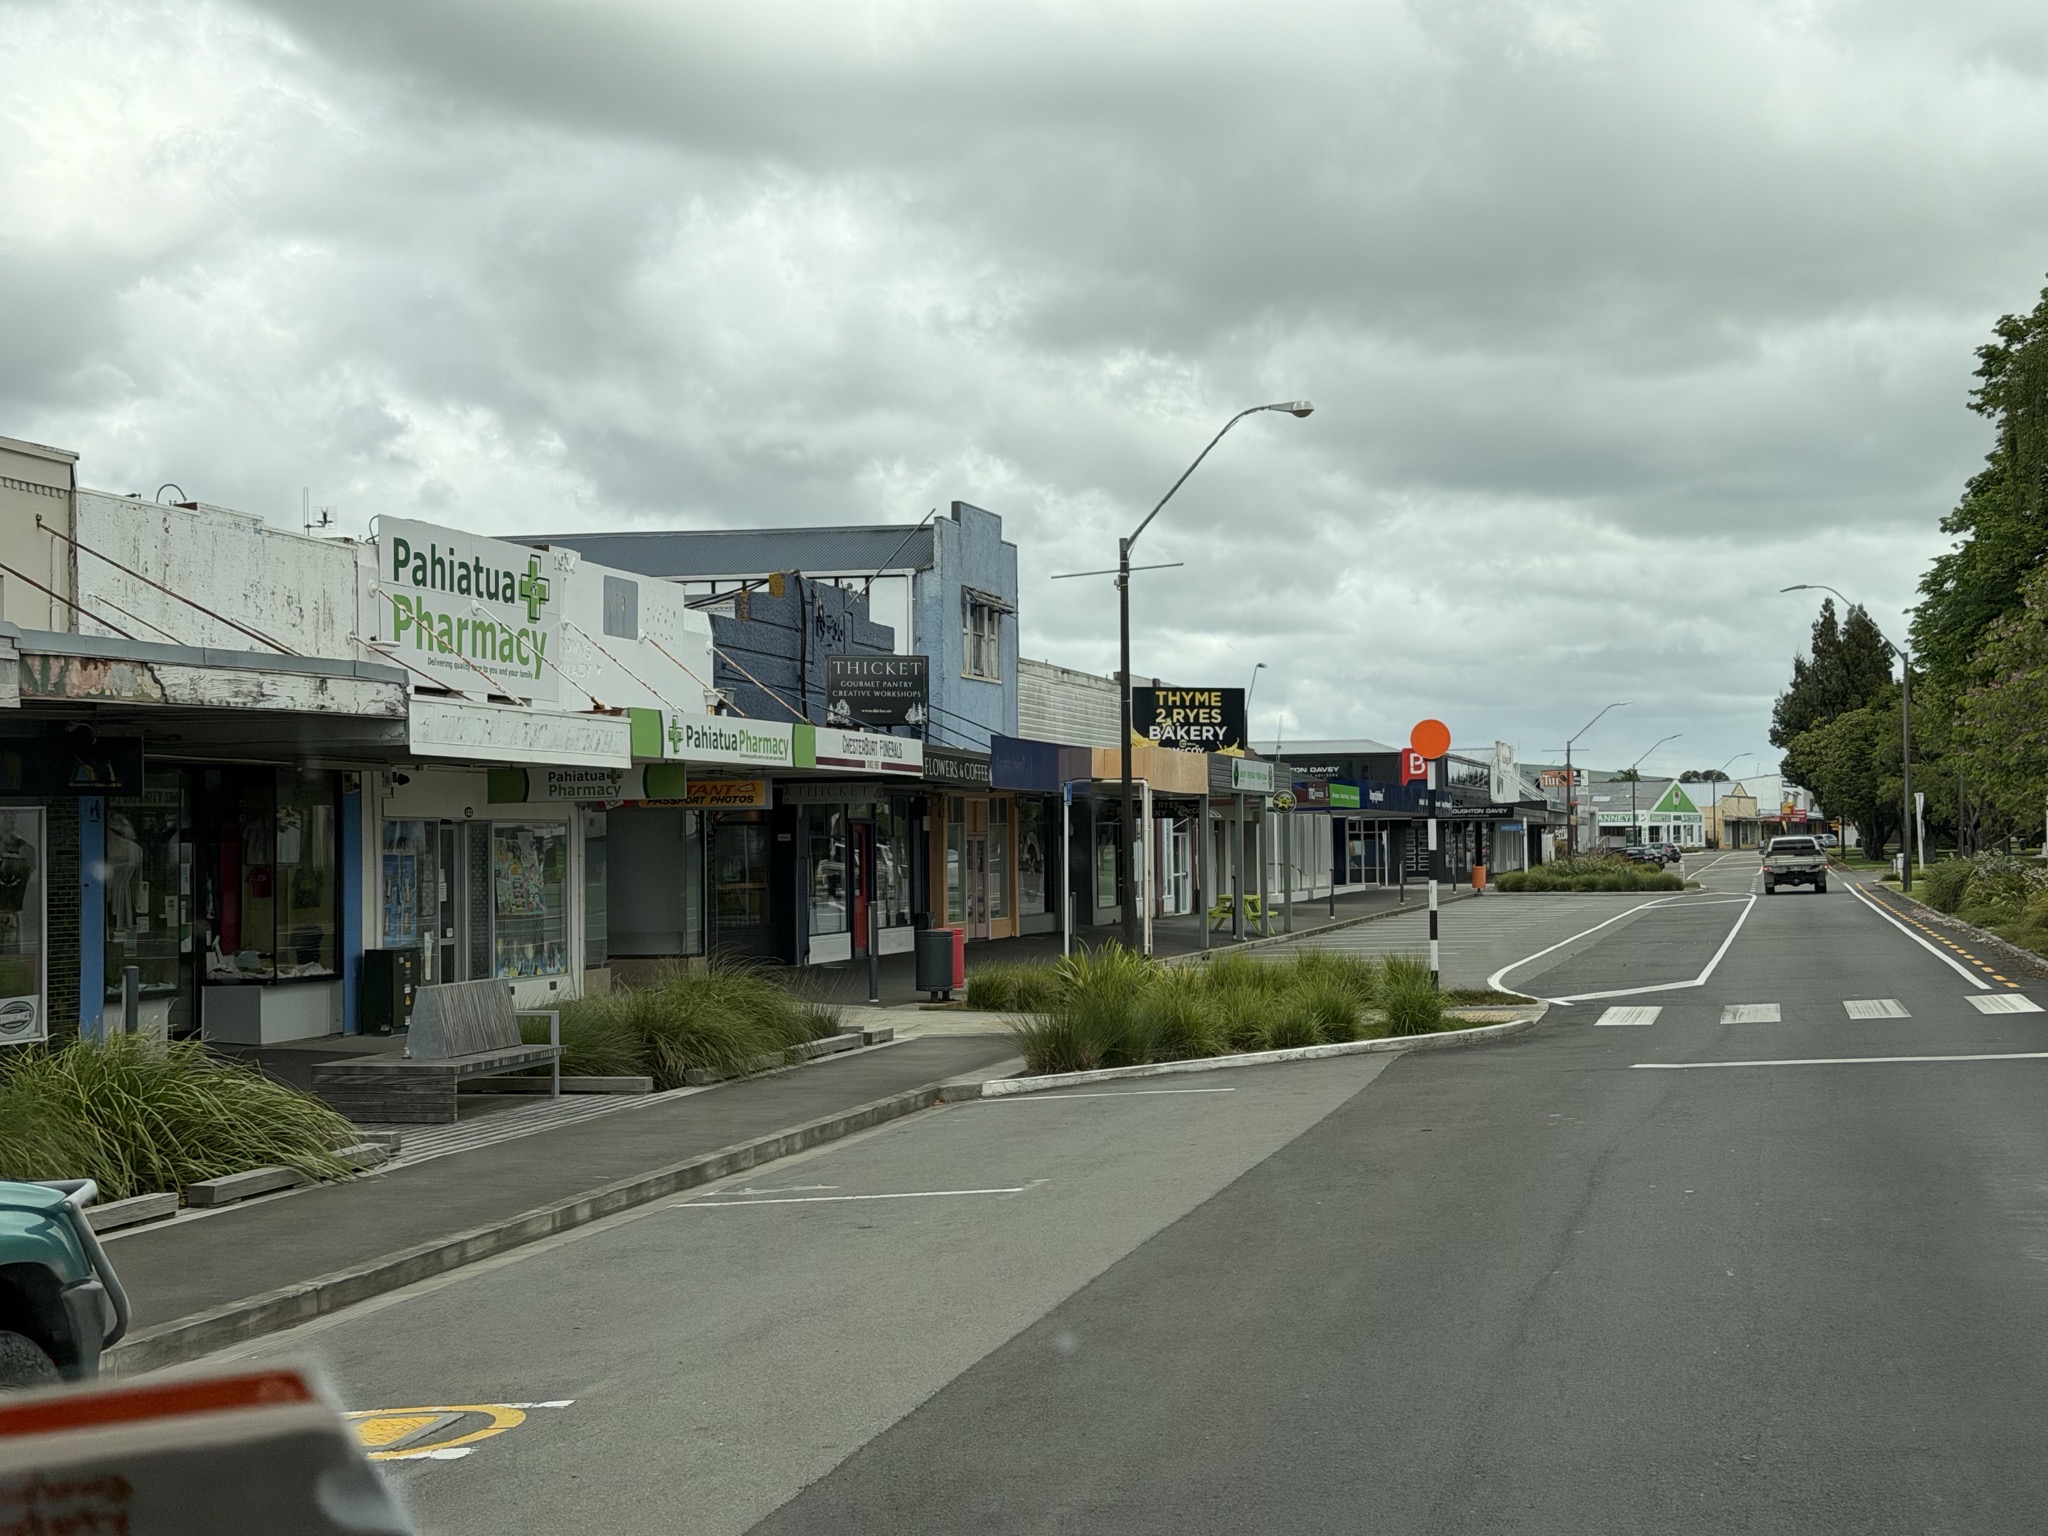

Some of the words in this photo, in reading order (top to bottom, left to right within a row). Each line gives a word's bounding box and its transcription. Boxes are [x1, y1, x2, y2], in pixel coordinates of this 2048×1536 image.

[393, 537, 516, 604] Pahiatua
[393, 593, 548, 680] Pharmacy
[427, 657, 453, 670] Delivering
[453, 662, 470, 672] quality
[482, 665, 488, 673] to
[508, 670, 519, 679] your
[519, 670, 533, 680] family
[832, 661, 922, 676] THICKET
[840, 680, 880, 688] GOURMET
[873, 690, 921, 698] WORKSHOPS
[1155, 691, 1222, 706] THYME
[1155, 708, 1167, 723] 2
[1173, 708, 1222, 723] RYES
[1149, 725, 1228, 741] BAKERY
[686, 724, 738, 752] Pahiatua
[739, 729, 789, 760] Pharmacy
[924, 757, 959, 779] FLOWERS
[959, 764, 964, 778] &
[964, 762, 989, 782] COFFEE
[1409, 752, 1426, 775] B
[548, 771, 605, 782] Pahiatua
[1543, 774, 1559, 786] Tui
[548, 784, 622, 798] Pharmacy
[709, 794, 755, 804] PHOTOS
